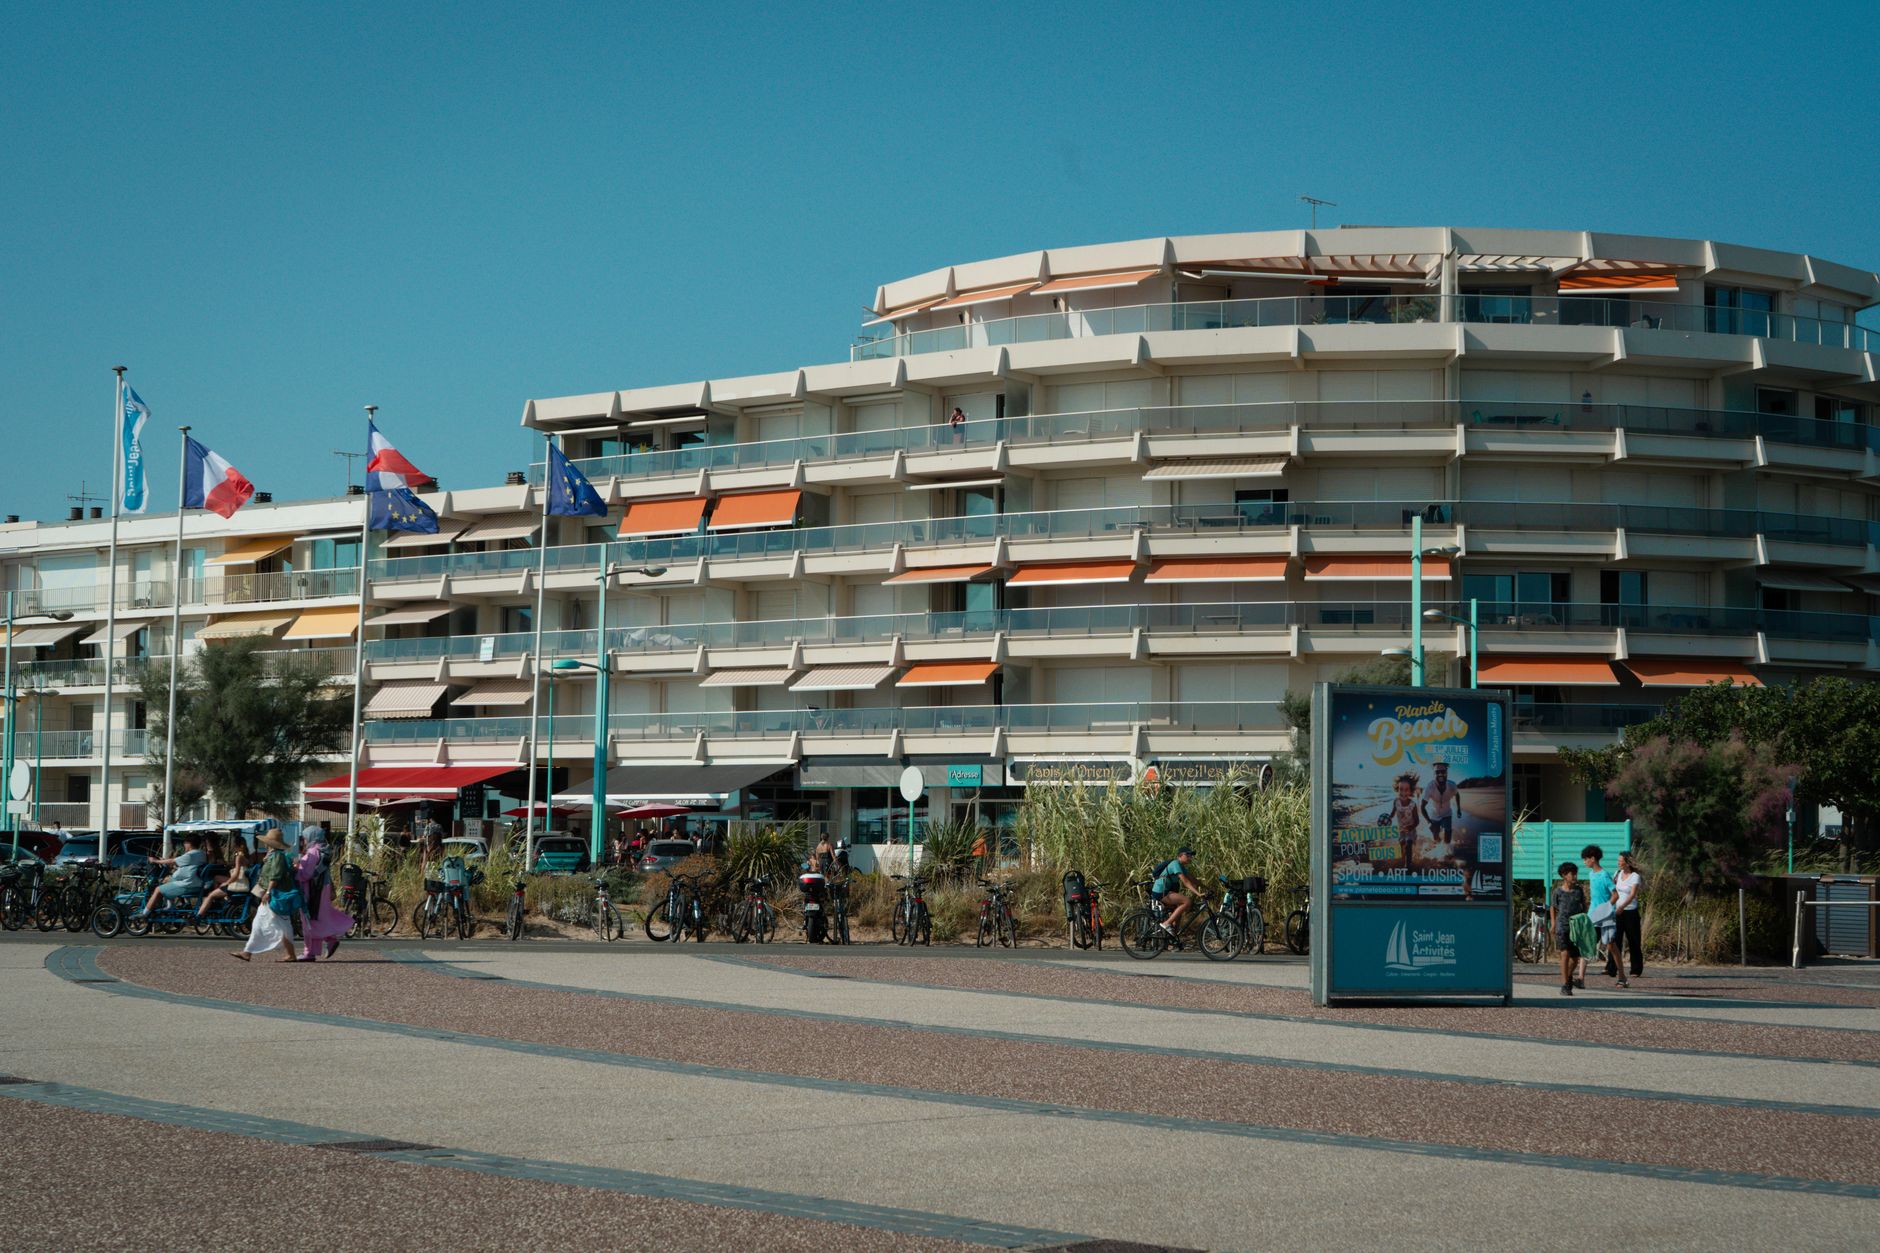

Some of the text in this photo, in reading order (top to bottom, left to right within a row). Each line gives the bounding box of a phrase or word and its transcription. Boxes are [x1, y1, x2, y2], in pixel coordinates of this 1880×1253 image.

[1394, 700, 1446, 720] Planète
[1367, 707, 1469, 767] Beach
[949, 769, 979, 783] l'Adresse
[1161, 764, 1223, 778] erveilles
[1340, 843, 1367, 856] POUR
[1369, 847, 1395, 860] TOUS
[1338, 867, 1464, 882] SPORT ART LOISIRS
[1412, 930, 1455, 944] Saint Jean
[1412, 944, 1455, 957] Activités
